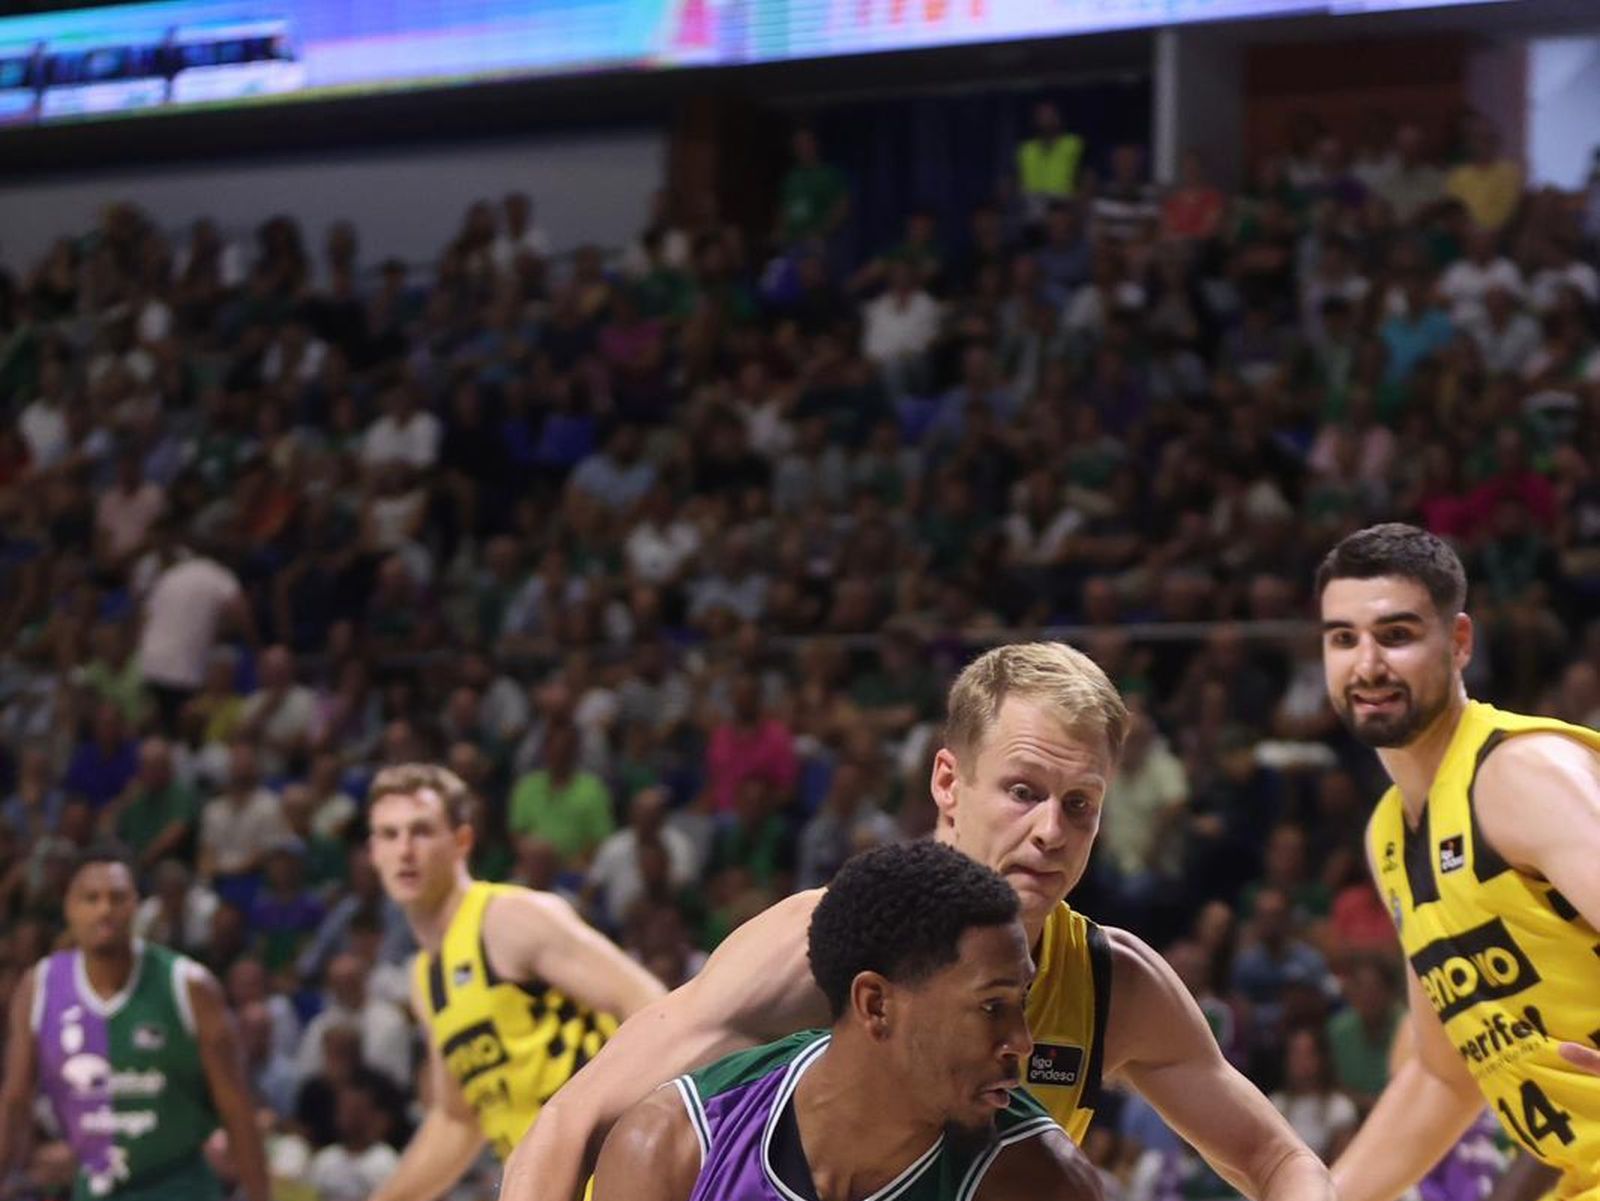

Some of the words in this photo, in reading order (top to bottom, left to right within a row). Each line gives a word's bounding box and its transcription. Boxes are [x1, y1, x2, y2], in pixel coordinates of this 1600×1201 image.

[1420, 946, 1520, 1013] enovo
[1030, 1069, 1076, 1082] endesa
[1497, 1079, 1577, 1158] 14
